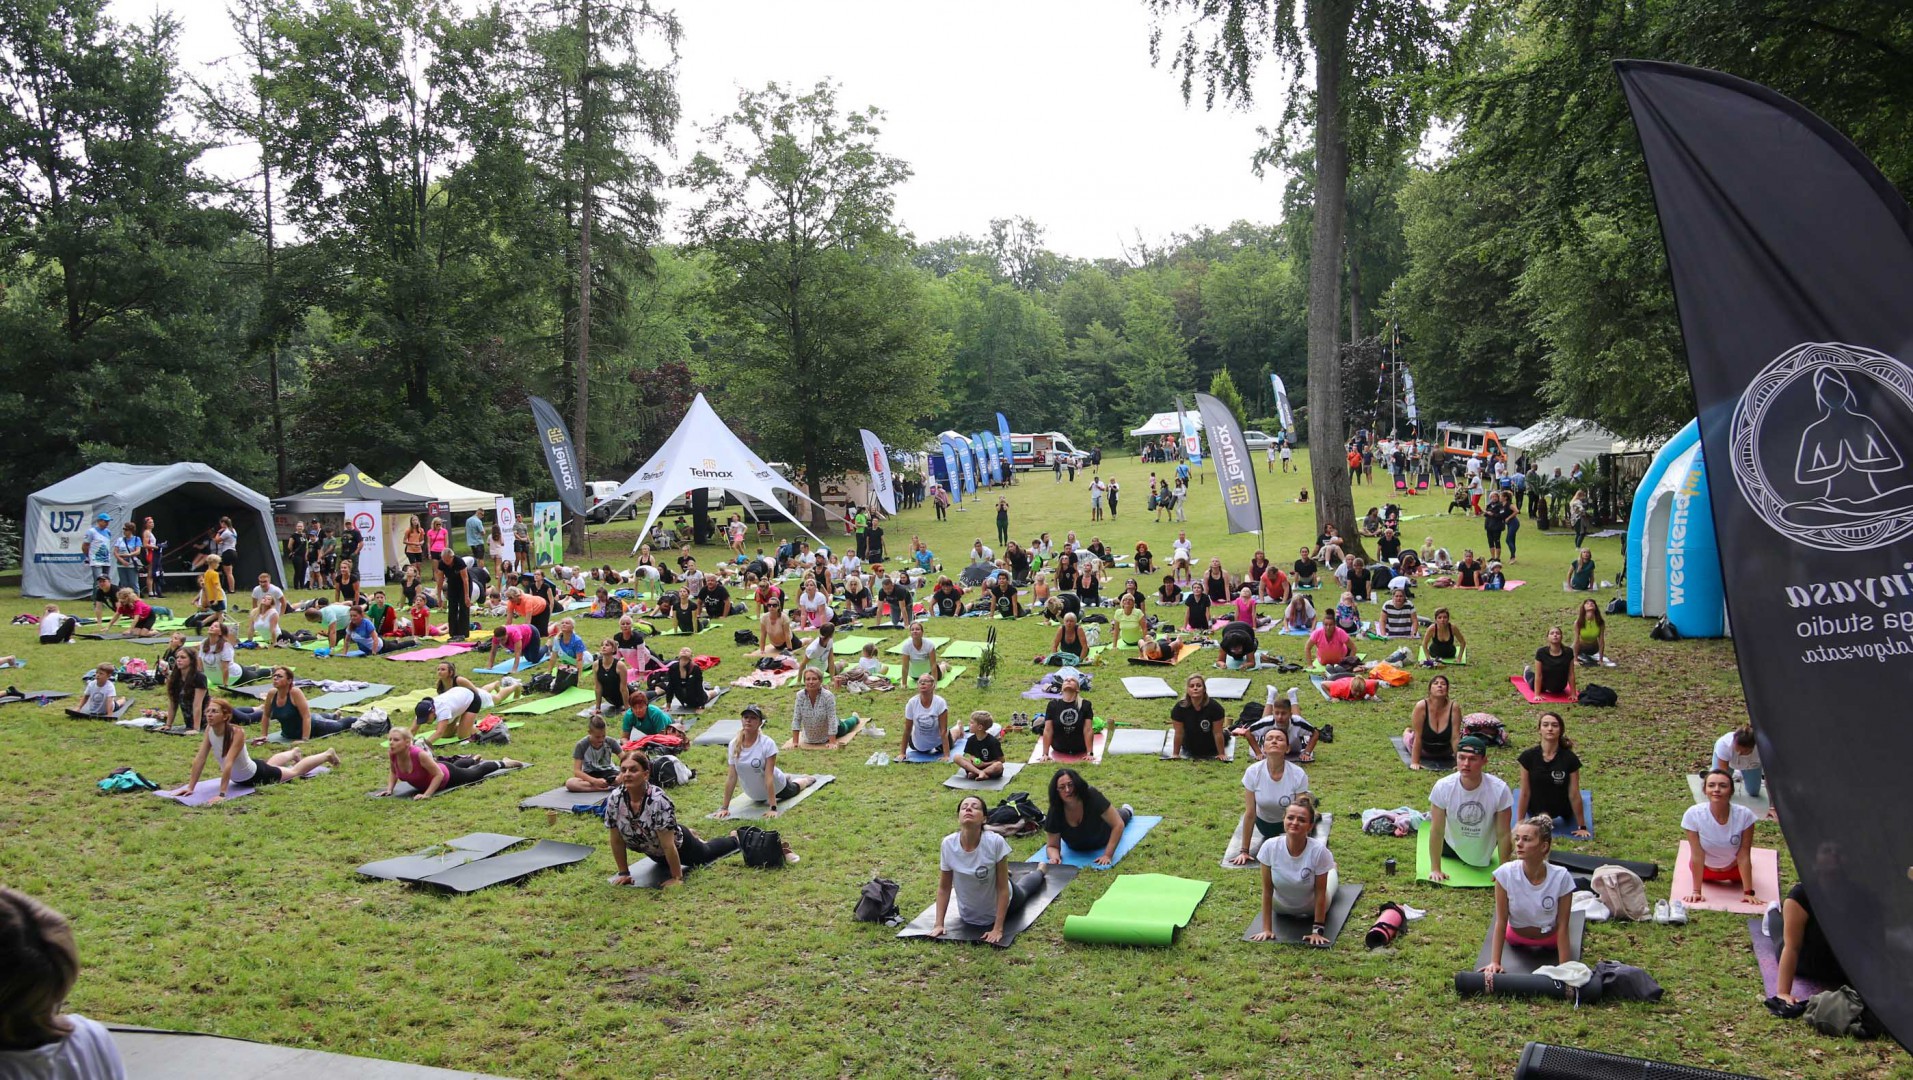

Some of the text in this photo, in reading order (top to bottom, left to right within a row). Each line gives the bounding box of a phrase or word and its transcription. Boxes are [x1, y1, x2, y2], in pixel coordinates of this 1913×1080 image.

[689, 467, 733, 478] Telmax
[50, 510, 84, 533] U57
[1667, 494, 1690, 606] weekend
